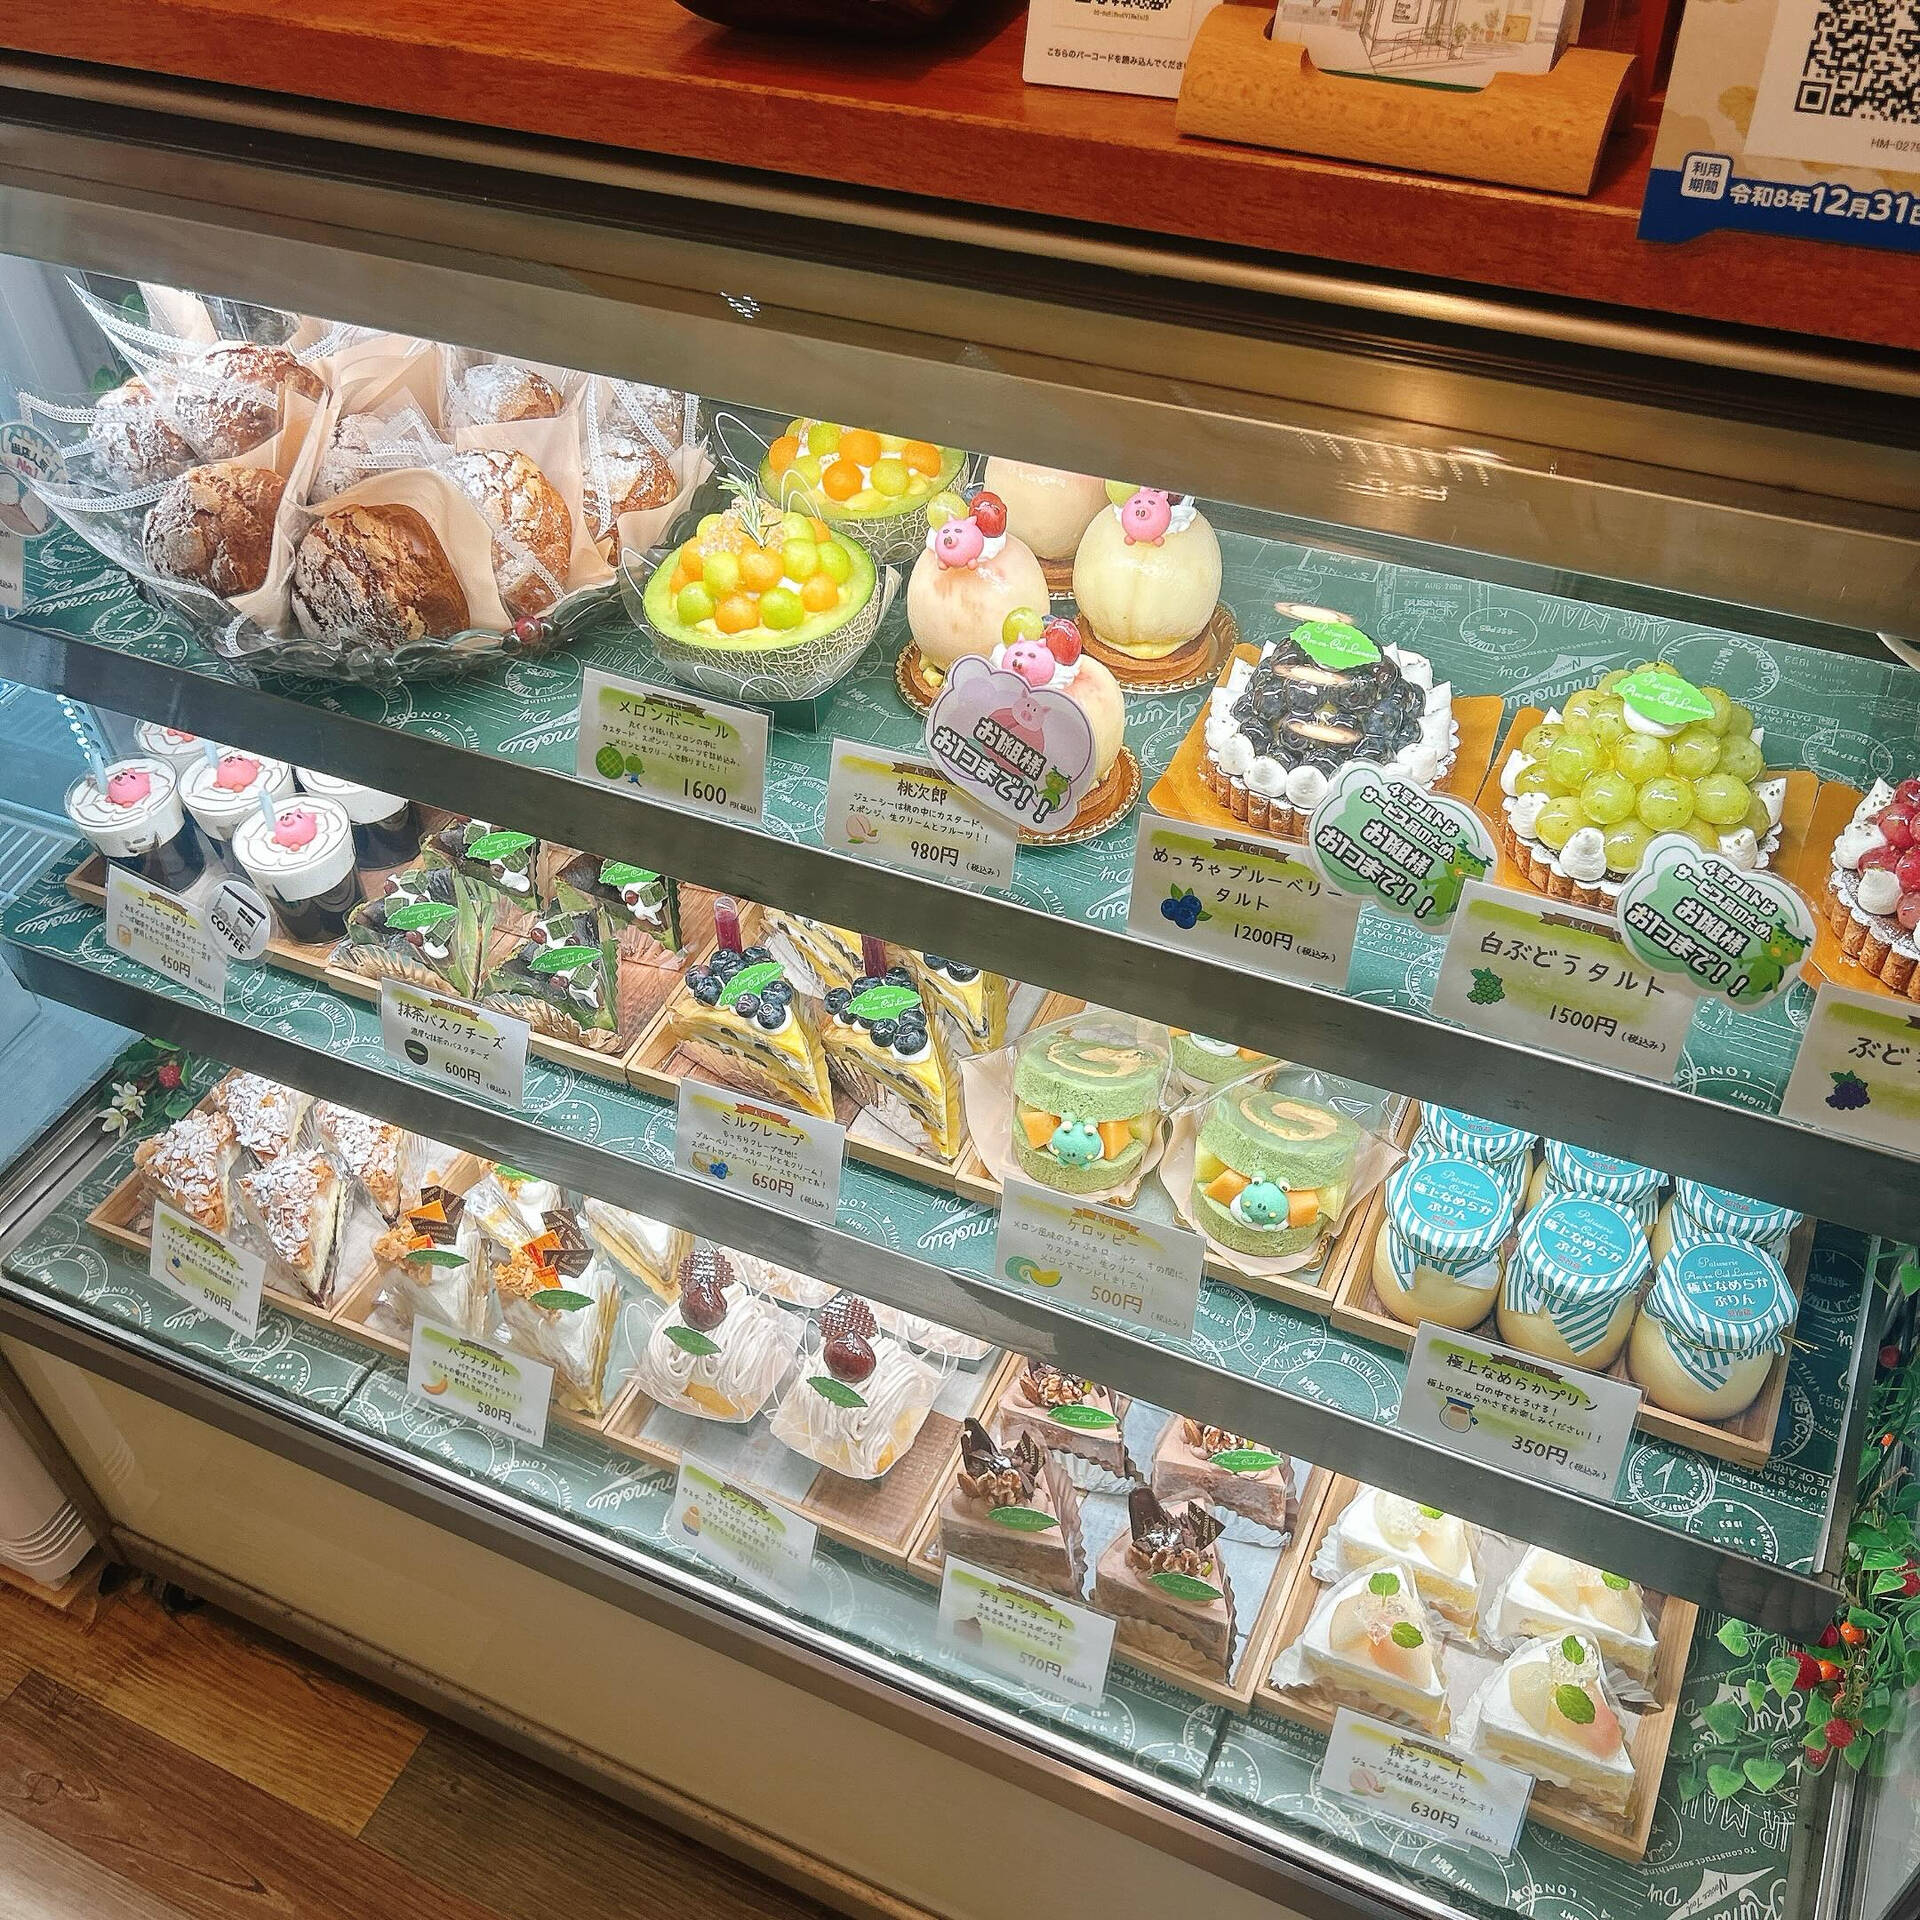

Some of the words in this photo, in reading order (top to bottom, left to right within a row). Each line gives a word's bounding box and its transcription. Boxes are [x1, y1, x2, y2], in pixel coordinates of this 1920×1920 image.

[1691, 161, 1722, 178] 利用
[1688, 177, 1718, 195] 期間
[897, 778, 948, 806] 桃次郎
[910, 840, 959, 867] 980円
[1152, 846, 1344, 898] めっちゃブルーベリー
[137, 896, 197, 930] コーヒーゼリー
[1216, 888, 1271, 911] タルト
[210, 914, 248, 955] COFFEE
[1233, 924, 1293, 951] 1200円
[1362, 926, 1393, 941] DAYS
[1374, 919, 1391, 931] OF
[1393, 924, 1423, 939] DATE
[160, 954, 191, 978] 450円
[1479, 930, 1665, 997] 白ぶどうタルト
[398, 1001, 506, 1050] 抹茶バスクチーズ
[1550, 1004, 1618, 1037] 1500円
[1848, 1037, 1920, 1073] ぶど
[445, 1062, 481, 1085] 600円
[721, 1112, 805, 1146] ミルクレープ
[752, 1172, 794, 1198] 650円
[1413, 1182, 1493, 1217] 極上なめらか
[1067, 1219, 1139, 1247] ケロッピー
[1544, 1217, 1624, 1264] 極上なめらか
[1687, 1277, 1769, 1294] 極上なめらか
[204, 1288, 231, 1312] 570円
[1091, 1286, 1143, 1315] 500円
[1265, 1309, 1303, 1331] 1968
[449, 1347, 510, 1376] バナナタルト
[1445, 1353, 1599, 1412] 極上なめらかプリン
[477, 1401, 512, 1425] 580円
[1511, 1435, 1569, 1466] 350円
[1757, 1469, 1785, 1484] STAY
[1786, 1477, 1817, 1494] DAYS
[978, 1588, 1069, 1630] チョコショート
[1388, 1743, 1468, 1780] 桃ショート
[1410, 1801, 1460, 1829] 630円
